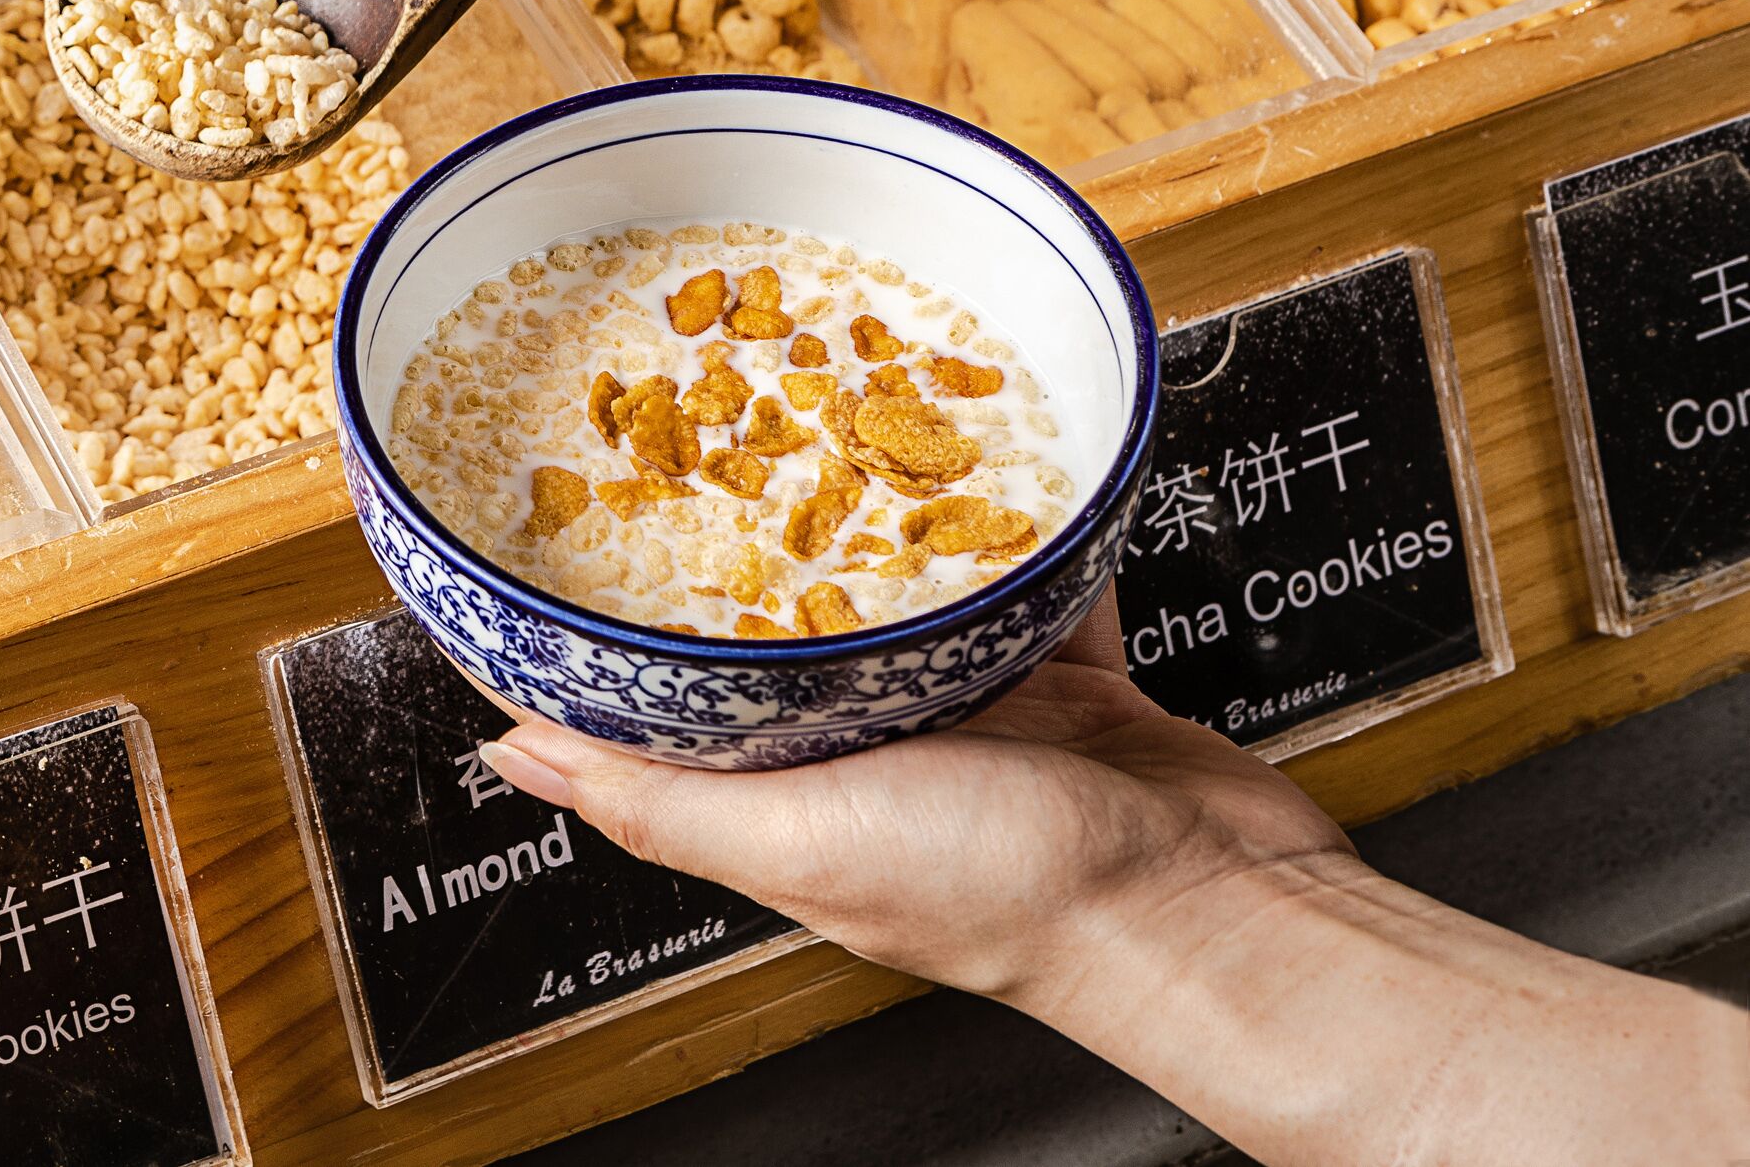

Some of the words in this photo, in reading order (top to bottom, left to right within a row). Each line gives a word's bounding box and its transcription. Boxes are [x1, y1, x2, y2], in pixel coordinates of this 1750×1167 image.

[1117, 411, 1370, 574] 茶饼干
[1122, 602, 1228, 672] cha
[1244, 519, 1453, 622] Cookies
[1224, 671, 1347, 730] Brasserie
[383, 812, 574, 932] Almond
[533, 970, 576, 1008] La
[586, 915, 727, 988] Brasserie
